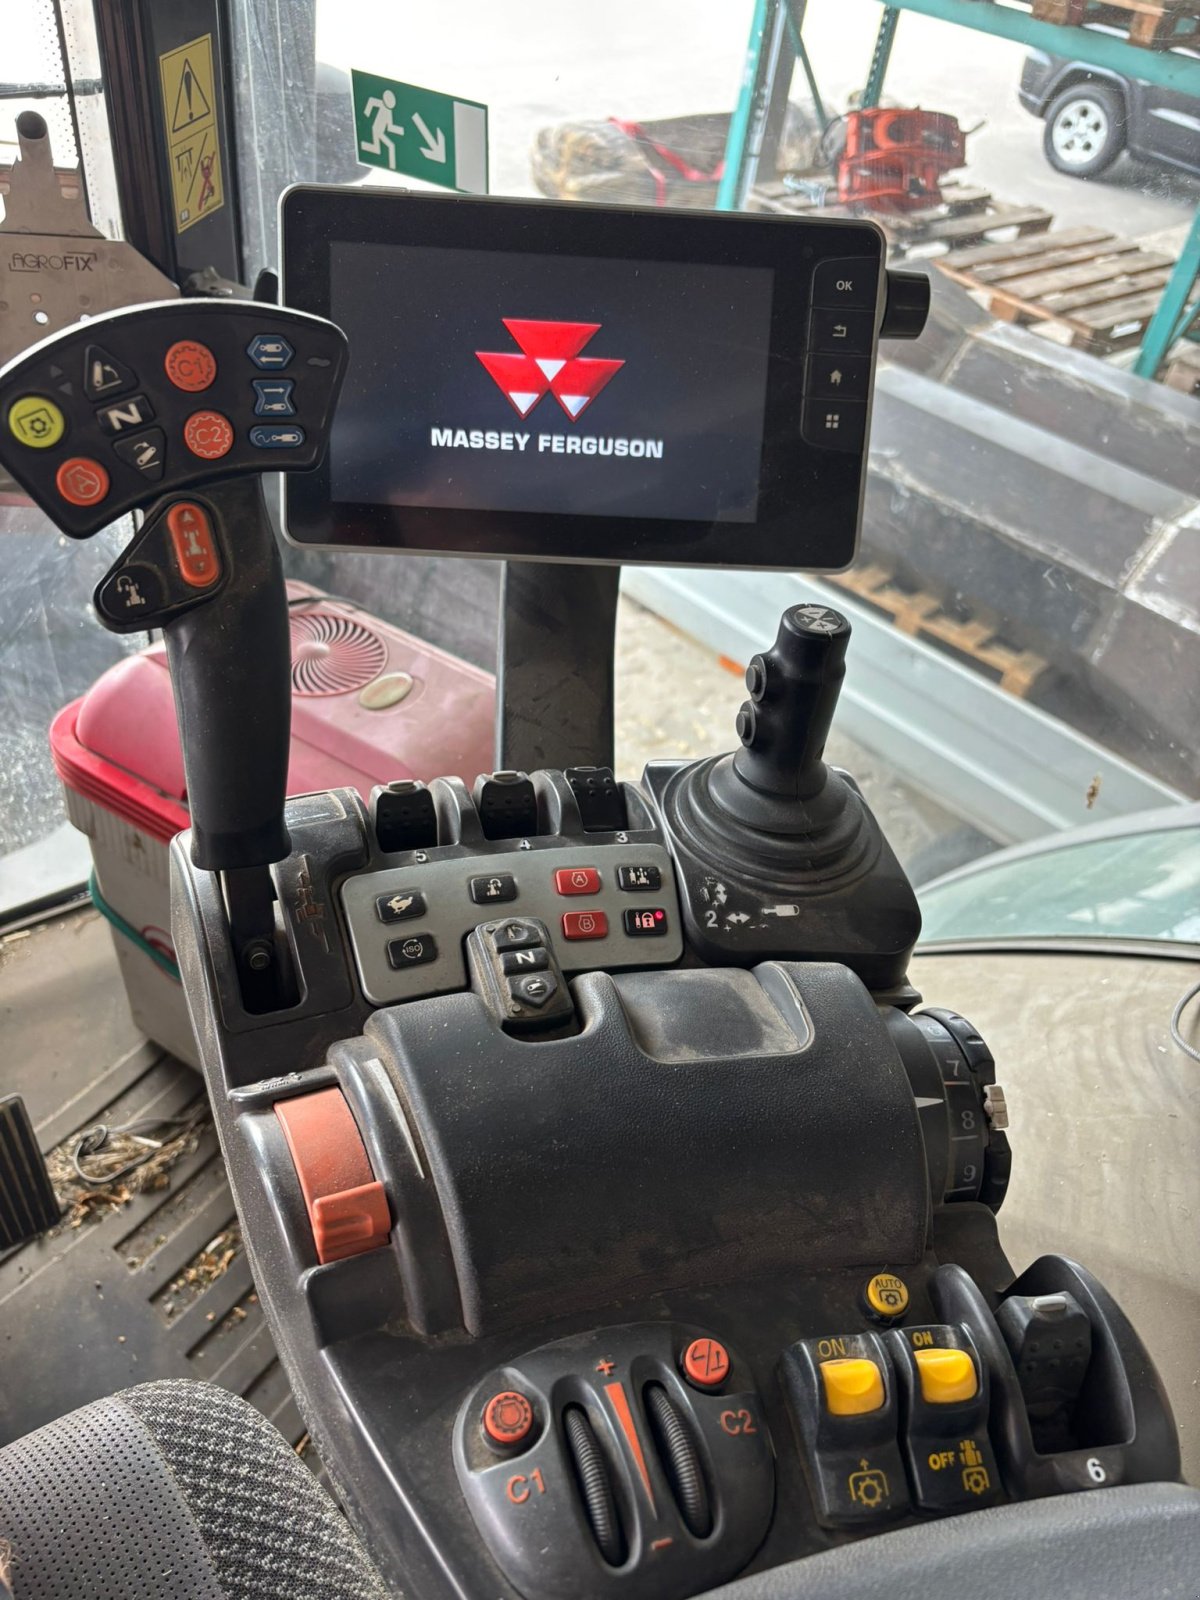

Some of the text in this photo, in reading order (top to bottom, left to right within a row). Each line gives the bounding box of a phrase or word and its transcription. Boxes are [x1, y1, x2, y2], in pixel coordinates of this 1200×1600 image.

[12, 252, 94, 272] AGROFIX
[836, 280, 853, 291] OK
[178, 356, 205, 377] C1
[107, 403, 142, 430] N
[196, 426, 222, 445] C2
[430, 427, 663, 458] MASSEY FERGUSON
[520, 838, 532, 850] 4
[616, 832, 628, 843] 3
[416, 850, 428, 863] 5
[575, 874, 585, 884] A
[582, 918, 592, 929] B
[705, 910, 719, 928] 2
[405, 944, 421, 953] ISO
[516, 950, 537, 965] N
[945, 1060, 960, 1077] 7
[961, 1110, 975, 1130] 8
[963, 1164, 976, 1183] 9
[875, 1279, 902, 1289] AUTO
[912, 1331, 933, 1346] ON
[818, 1338, 846, 1358] ON
[720, 1409, 757, 1437] C2
[928, 1452, 955, 1470] OFF
[1086, 1457, 1107, 1483] 6
[506, 1467, 546, 1504] C1
